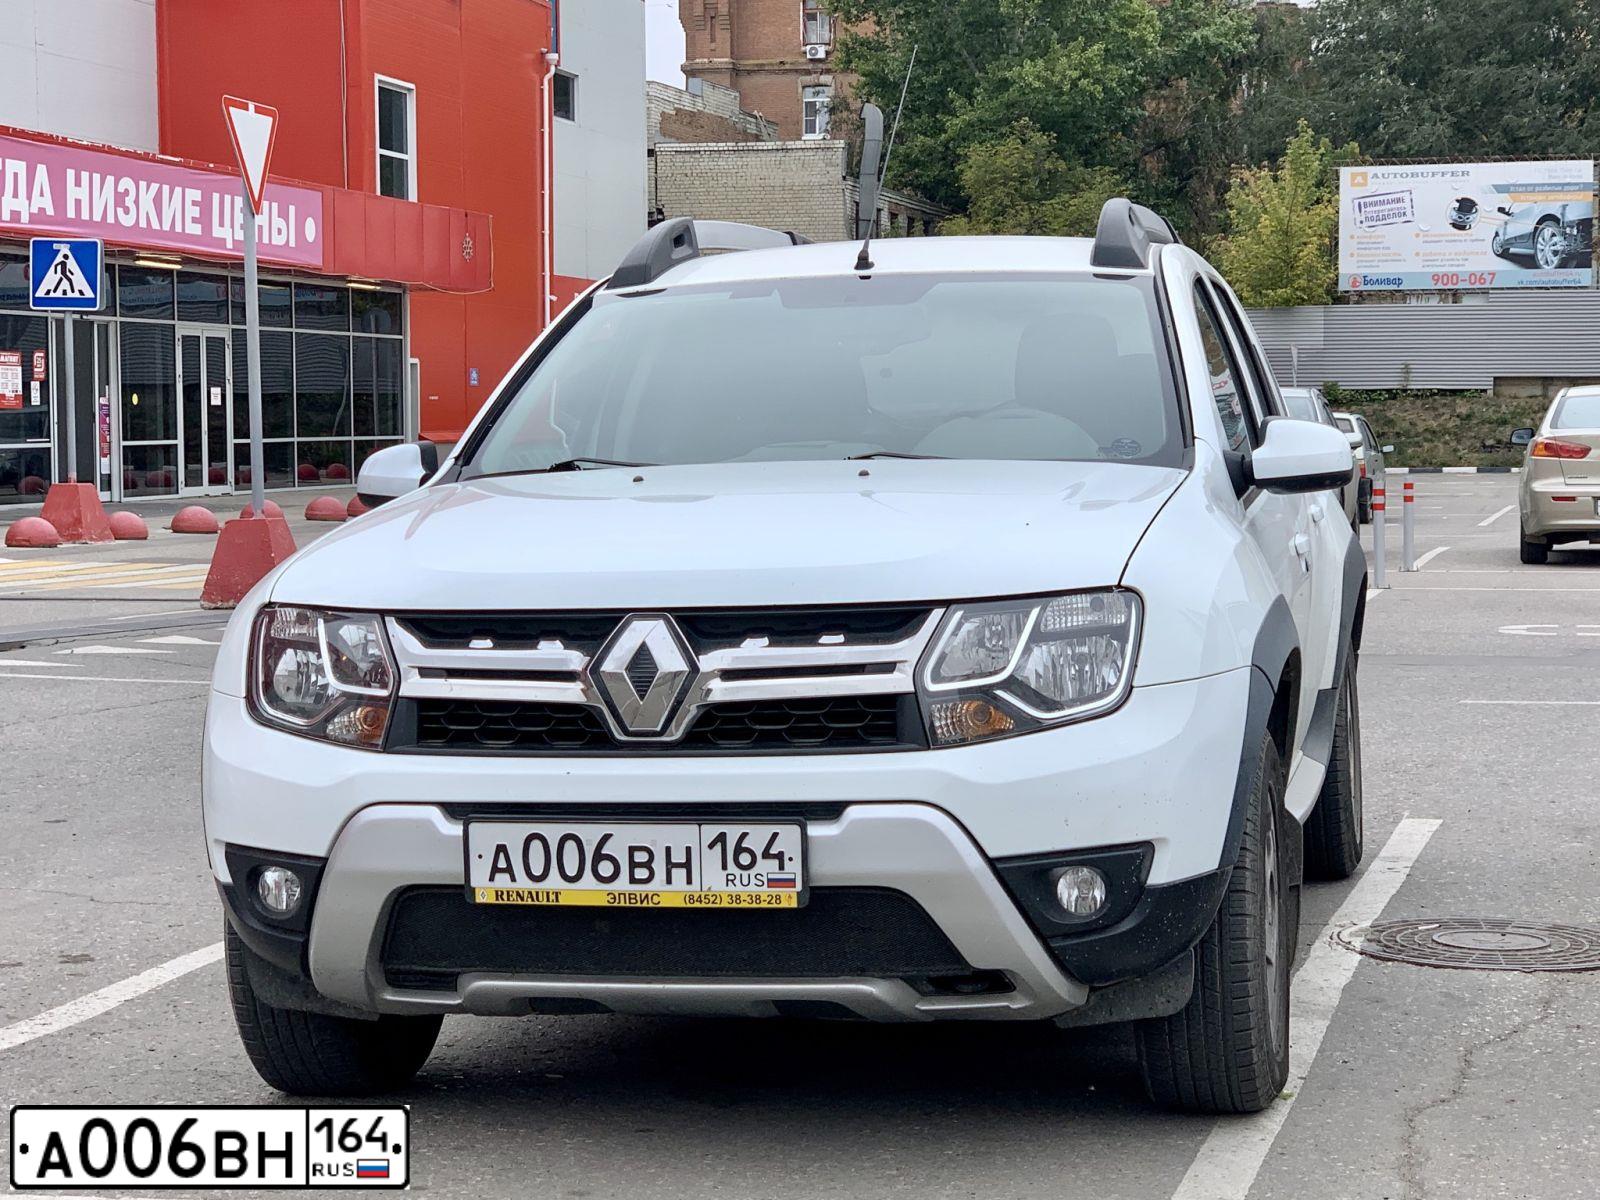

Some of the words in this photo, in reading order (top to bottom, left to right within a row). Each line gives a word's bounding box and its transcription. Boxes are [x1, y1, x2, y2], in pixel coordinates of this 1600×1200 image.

[1370, 170, 1471, 180] AUTOBUFFER
[0, 157, 55, 224] ДА
[66, 168, 202, 236] НИЗКИЕ
[1363, 196, 1406, 209] ВНИМАНИЕ
[1362, 275, 1404, 288] Боливар
[1431, 272, 1497, 286] 900-067
[707, 831, 785, 871] 164
[488, 832, 692, 885] А006ВН
[725, 872, 765, 888] RUS
[494, 890, 561, 904] RENAULT
[606, 892, 661, 906] ЭЛВИС
[683, 893, 723, 906] (8452)
[726, 893, 782, 906] 38-38-28
